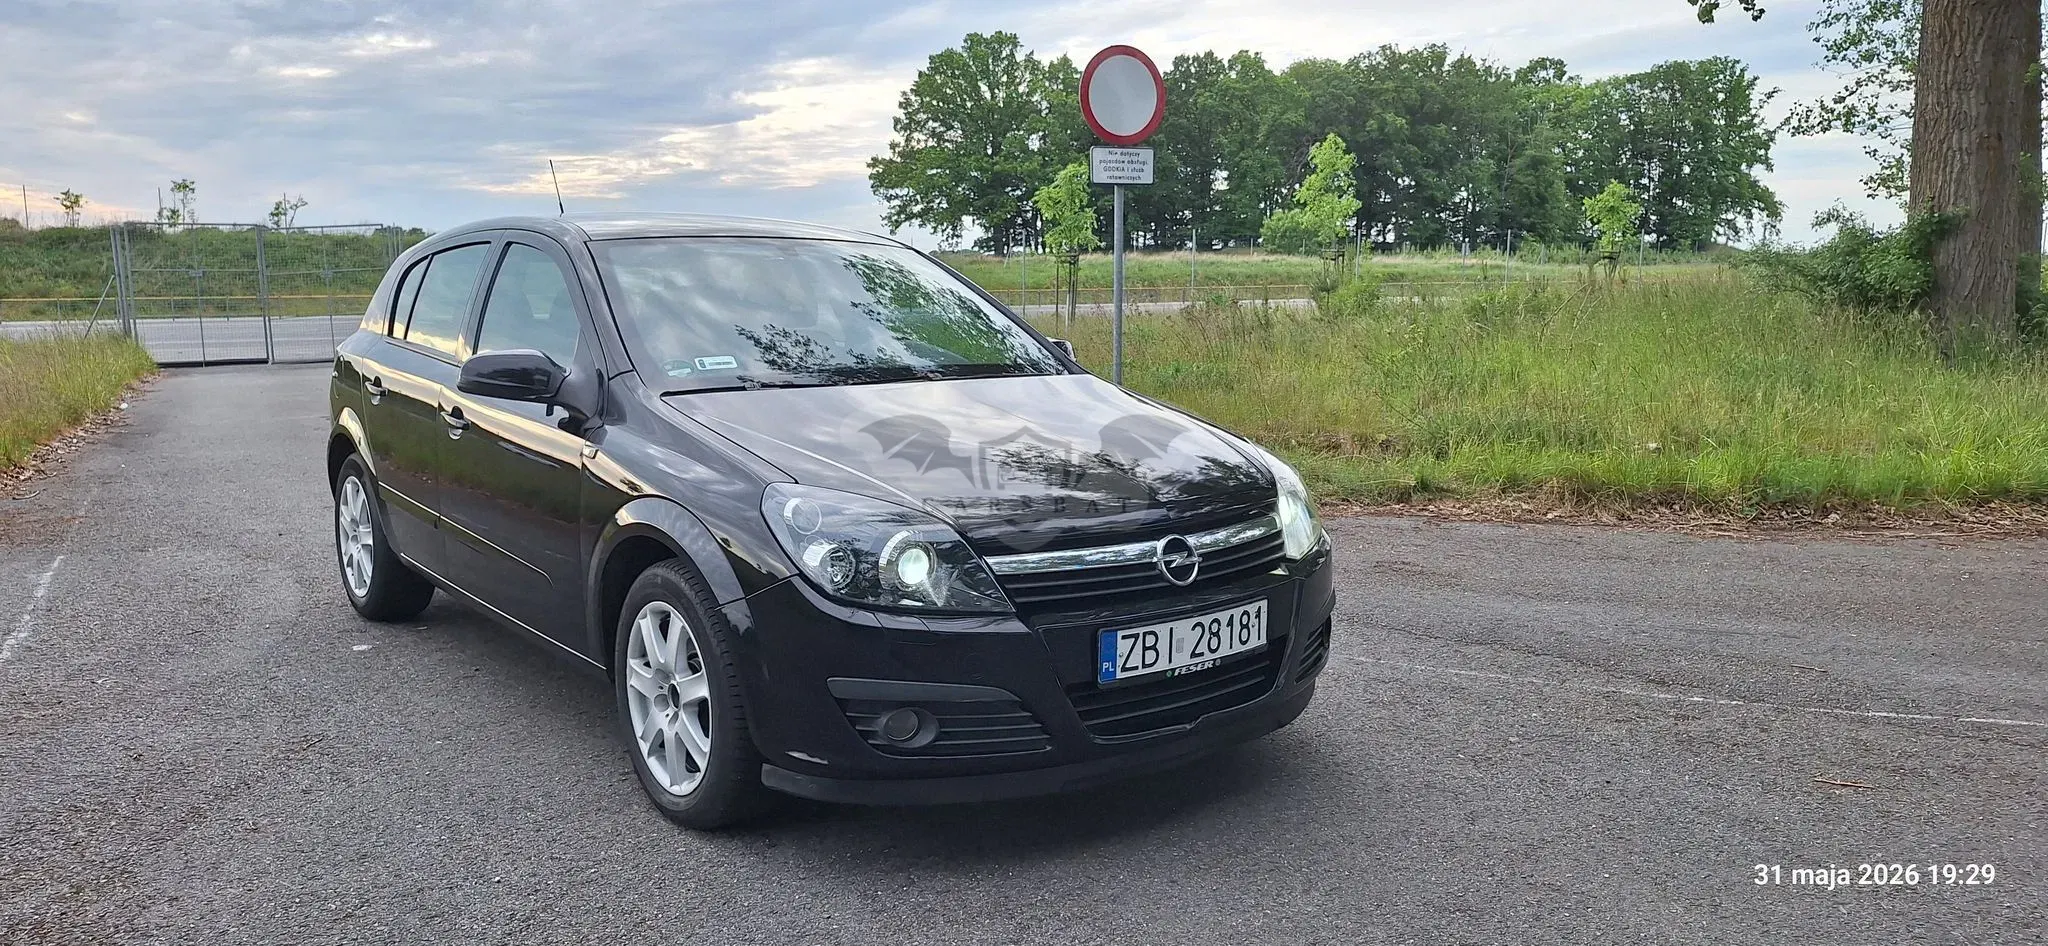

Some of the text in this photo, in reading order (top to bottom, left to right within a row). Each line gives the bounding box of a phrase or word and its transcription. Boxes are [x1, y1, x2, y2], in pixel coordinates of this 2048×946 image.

[1120, 605, 1262, 673] ZBI 28181
[1102, 661, 1115, 673] PL
[1173, 660, 1214, 676] FESER
